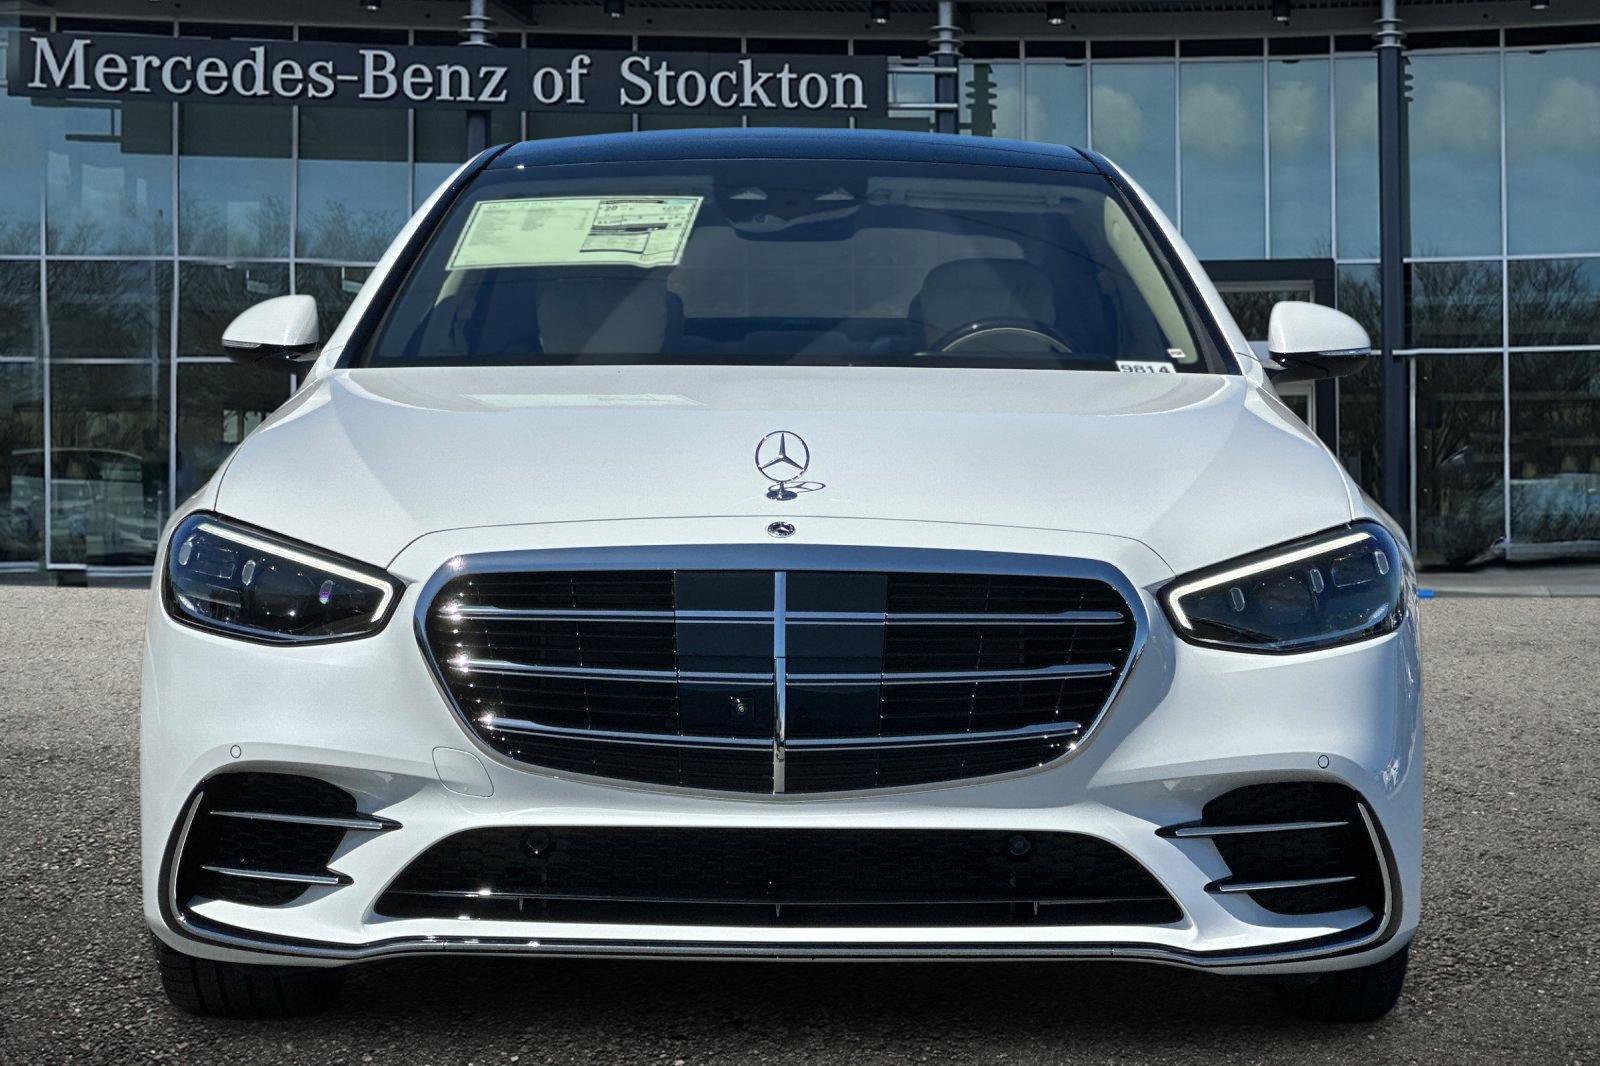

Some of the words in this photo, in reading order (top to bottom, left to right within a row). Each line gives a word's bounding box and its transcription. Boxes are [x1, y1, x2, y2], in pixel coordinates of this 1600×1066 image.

[27, 37, 508, 102] Mercedes-Benz
[532, 54, 591, 104] of
[620, 55, 868, 109] Stockton
